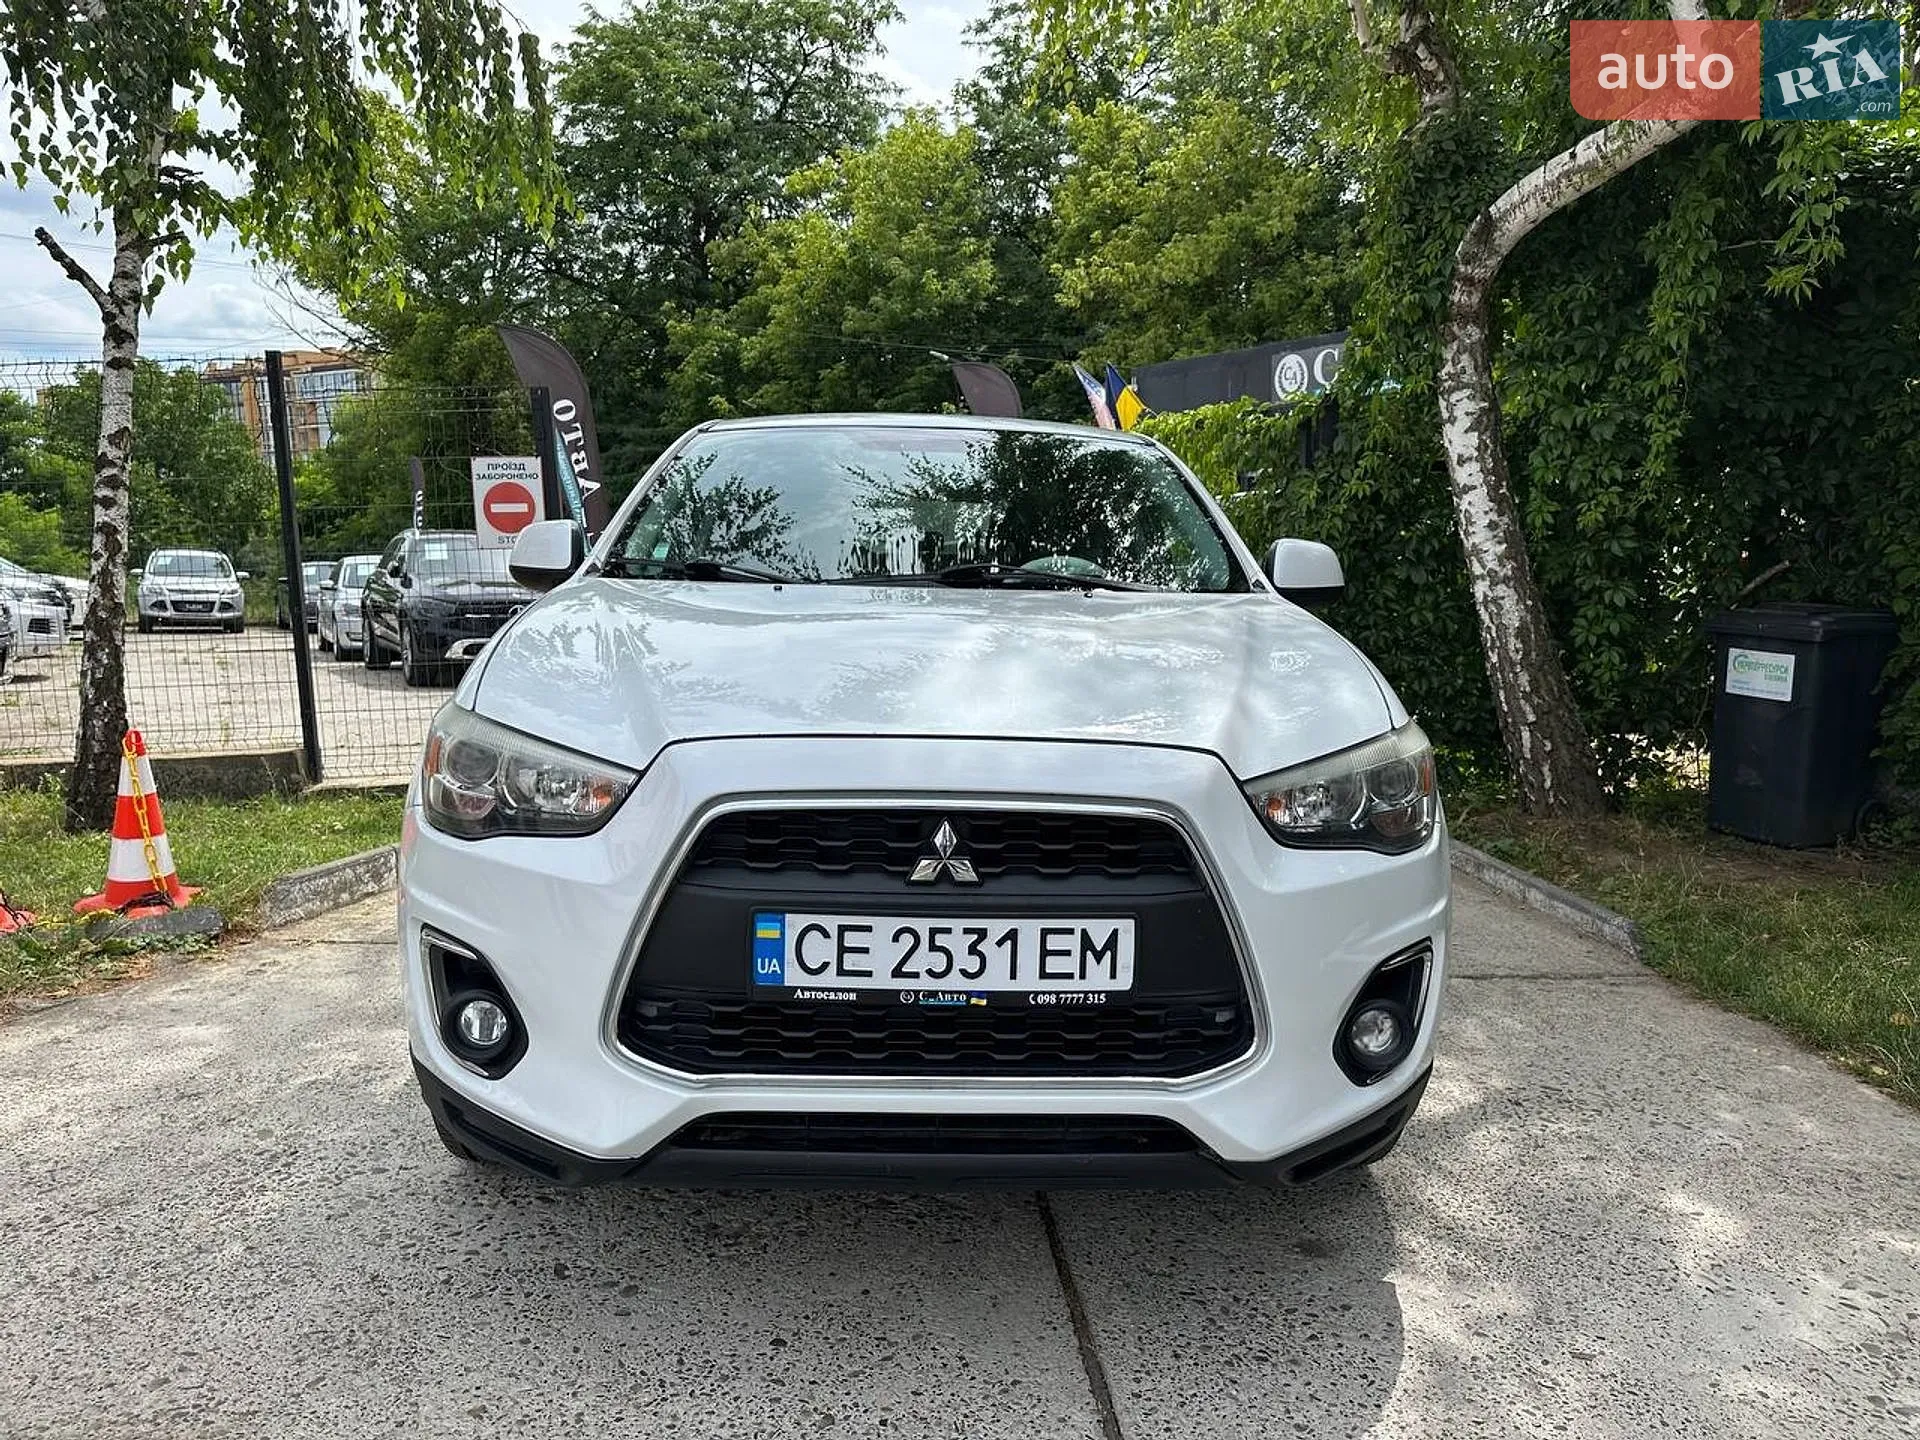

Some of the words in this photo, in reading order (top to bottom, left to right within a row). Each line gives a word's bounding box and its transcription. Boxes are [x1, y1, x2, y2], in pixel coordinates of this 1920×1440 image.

[487, 462, 527, 471] ПРОЇЗД
[475, 472, 539, 480] ЗАБОРОНЕНО
[498, 535, 518, 545] STO
[795, 923, 874, 977] CE
[891, 926, 1018, 980] 2531
[1039, 928, 1118, 980] EM
[757, 958, 781, 974] UA
[793, 989, 857, 1001] Автосалон
[1036, 993, 1057, 1004] 098
[1059, 993, 1084, 1004] 7777
[1086, 993, 1106, 1004] 315
